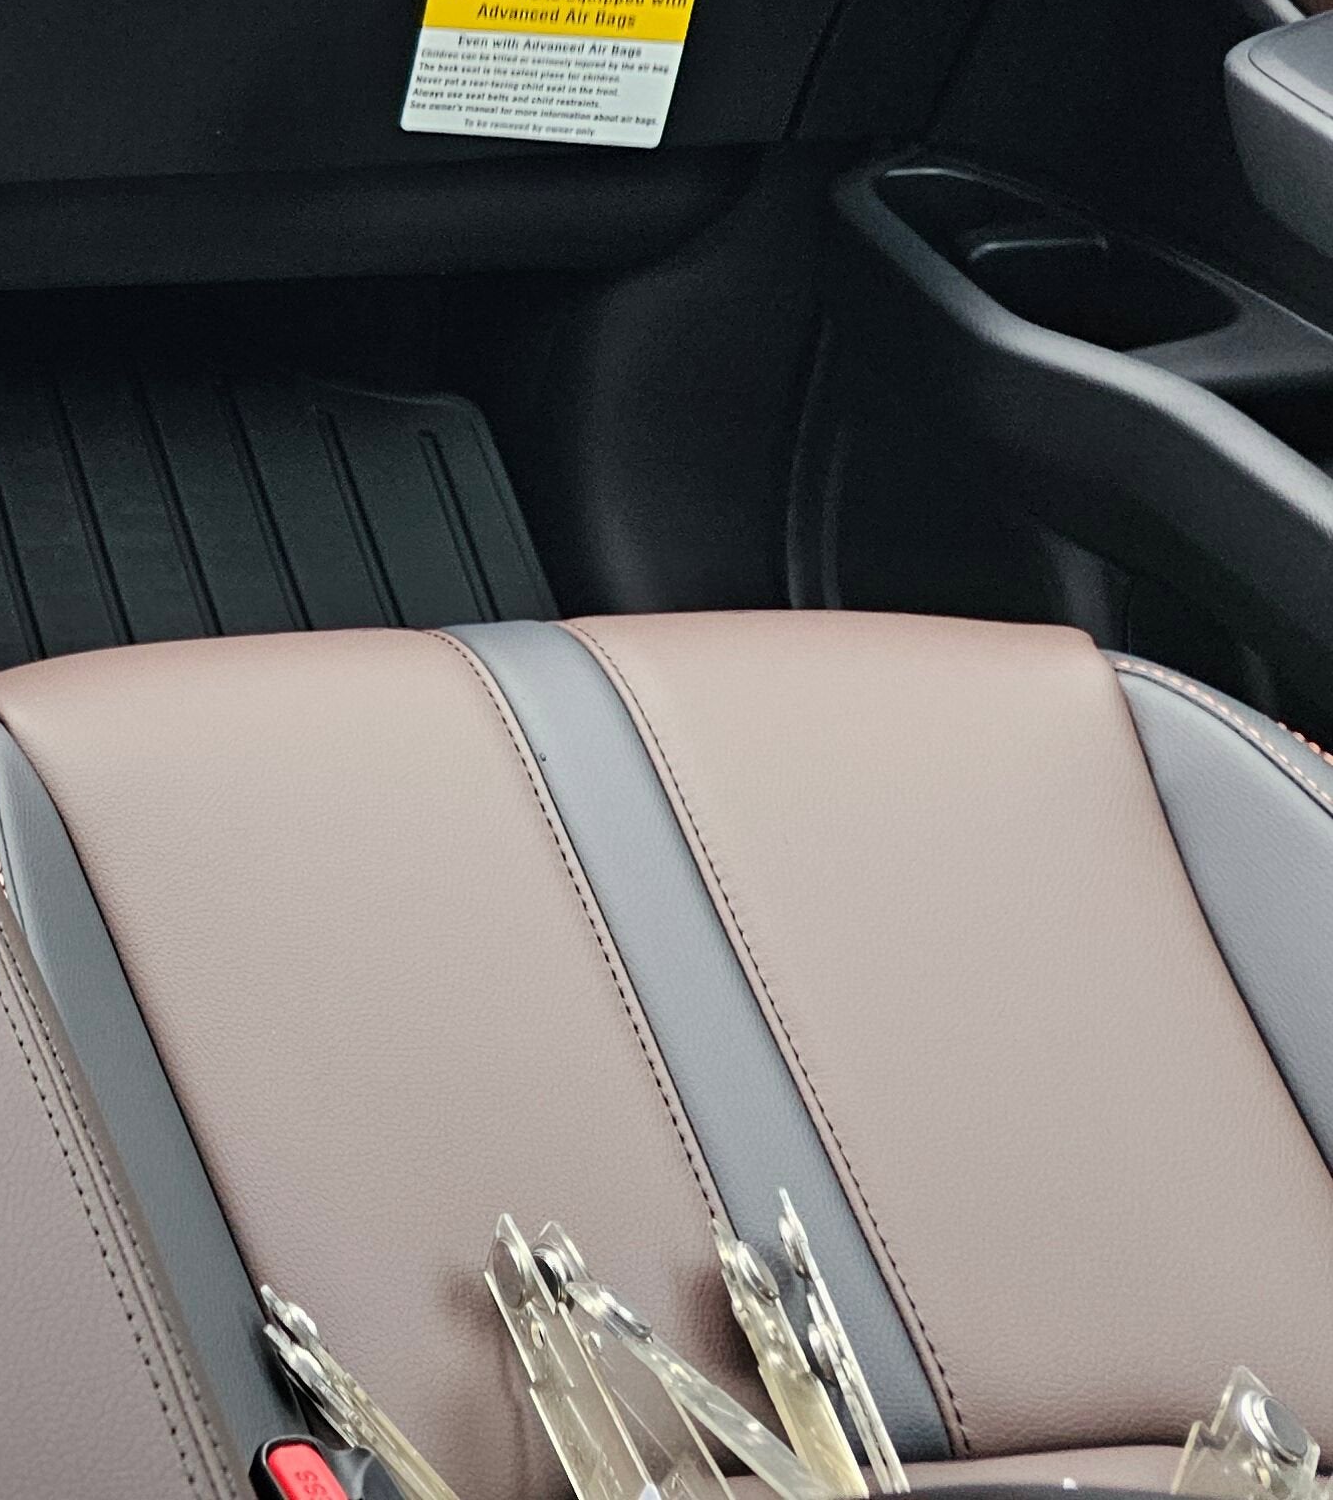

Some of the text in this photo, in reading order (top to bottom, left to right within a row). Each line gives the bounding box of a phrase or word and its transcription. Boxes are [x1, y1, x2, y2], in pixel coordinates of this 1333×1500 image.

[476, 4, 637, 31] Advanced Air Bags
[458, 35, 642, 59] Even with Advanced Air Bags
[419, 62, 435, 72] The
[437, 64, 458, 74] back
[461, 65, 481, 75] seat
[483, 66, 490, 75] is
[493, 67, 508, 77] the
[511, 68, 538, 78] safest
[540, 70, 565, 81] place
[568, 71, 581, 80] for
[416, 75, 442, 85] Never
[444, 77, 459, 87] put
[469, 79, 519, 91] rear-facing
[522, 82, 544, 92] child
[546, 84, 566, 94] seat
[568, 85, 577, 94] in
[579, 86, 594, 95] the
[412, 88, 444, 100] Always
[447, 90, 463, 100] use
[466, 91, 485, 101] seat
[487, 93, 509, 103] belts
[512, 94, 529, 104] and
[531, 96, 554, 106] child
[410, 100, 426, 110] See
[428, 103, 463, 113] owner's
[465, 104, 498, 115] manual
[501, 106, 512, 116] for
[515, 108, 538, 118] more
[540, 110, 591, 121] information
[593, 113, 618, 123] about
[620, 115, 633, 124] air
